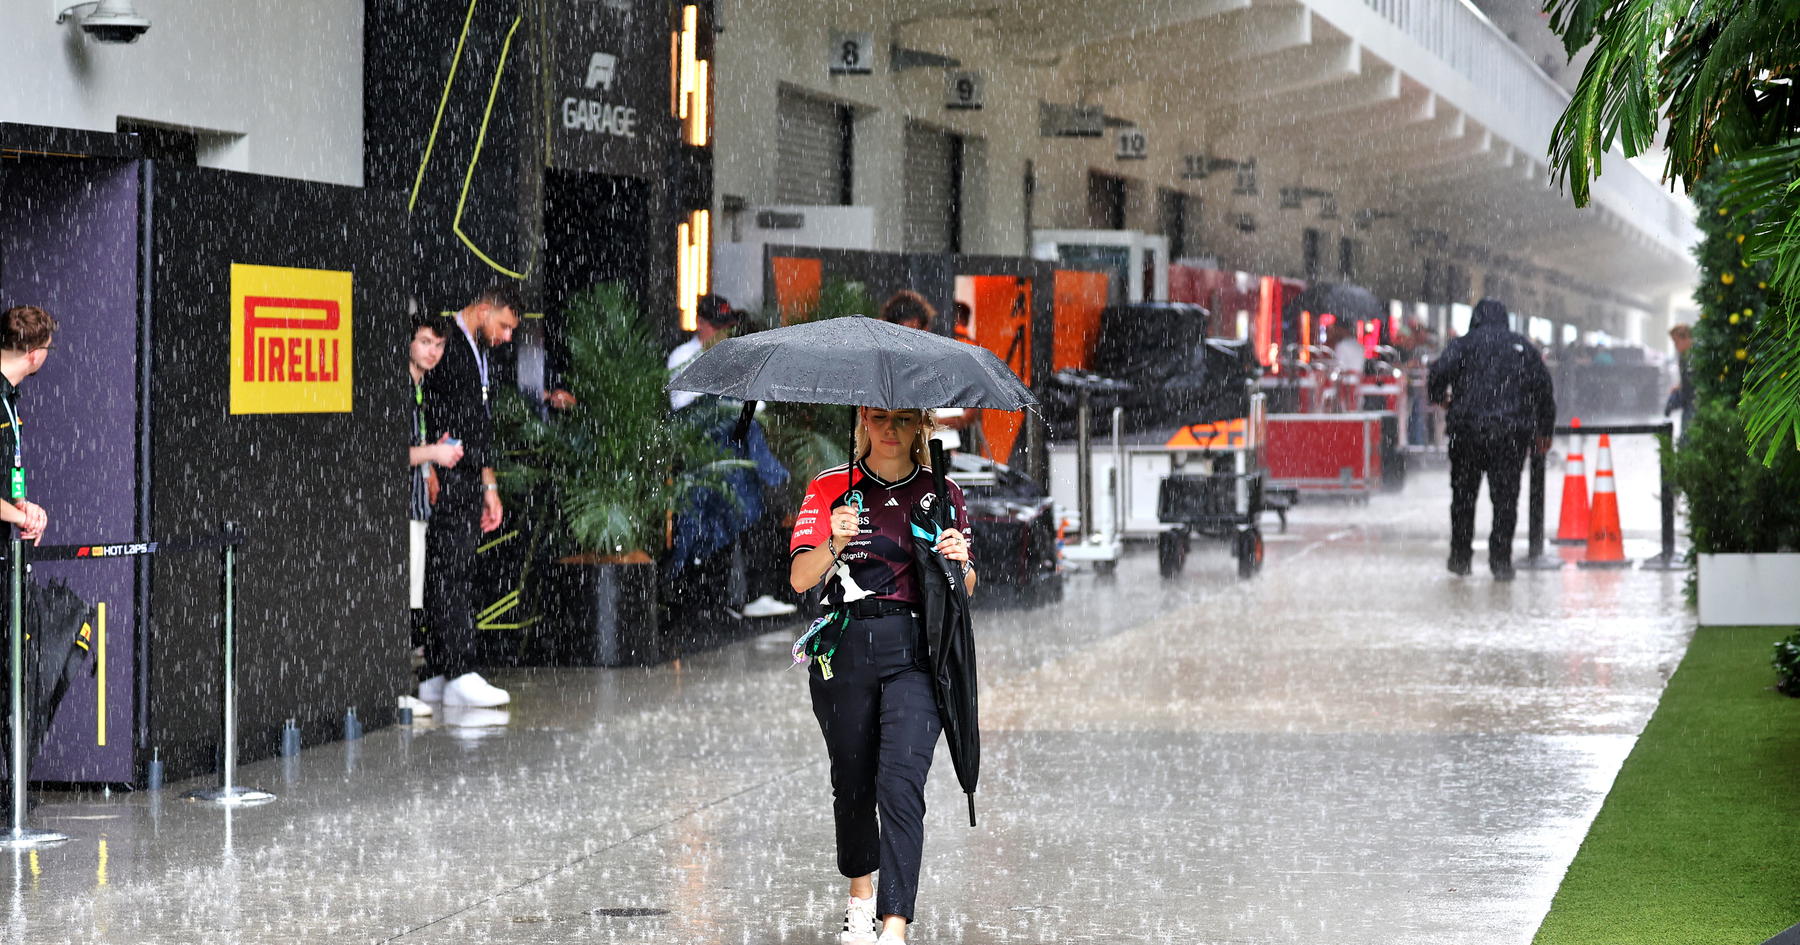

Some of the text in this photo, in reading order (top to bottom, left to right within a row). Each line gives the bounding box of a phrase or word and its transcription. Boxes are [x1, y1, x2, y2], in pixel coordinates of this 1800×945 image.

[842, 40, 859, 65] 8
[958, 78, 973, 101] 9
[563, 97, 636, 138] GARAGE
[1120, 133, 1145, 152] 10
[243, 296, 340, 382] PIRELLI
[857, 516, 870, 525] BS
[103, 545, 123, 556] HOT
